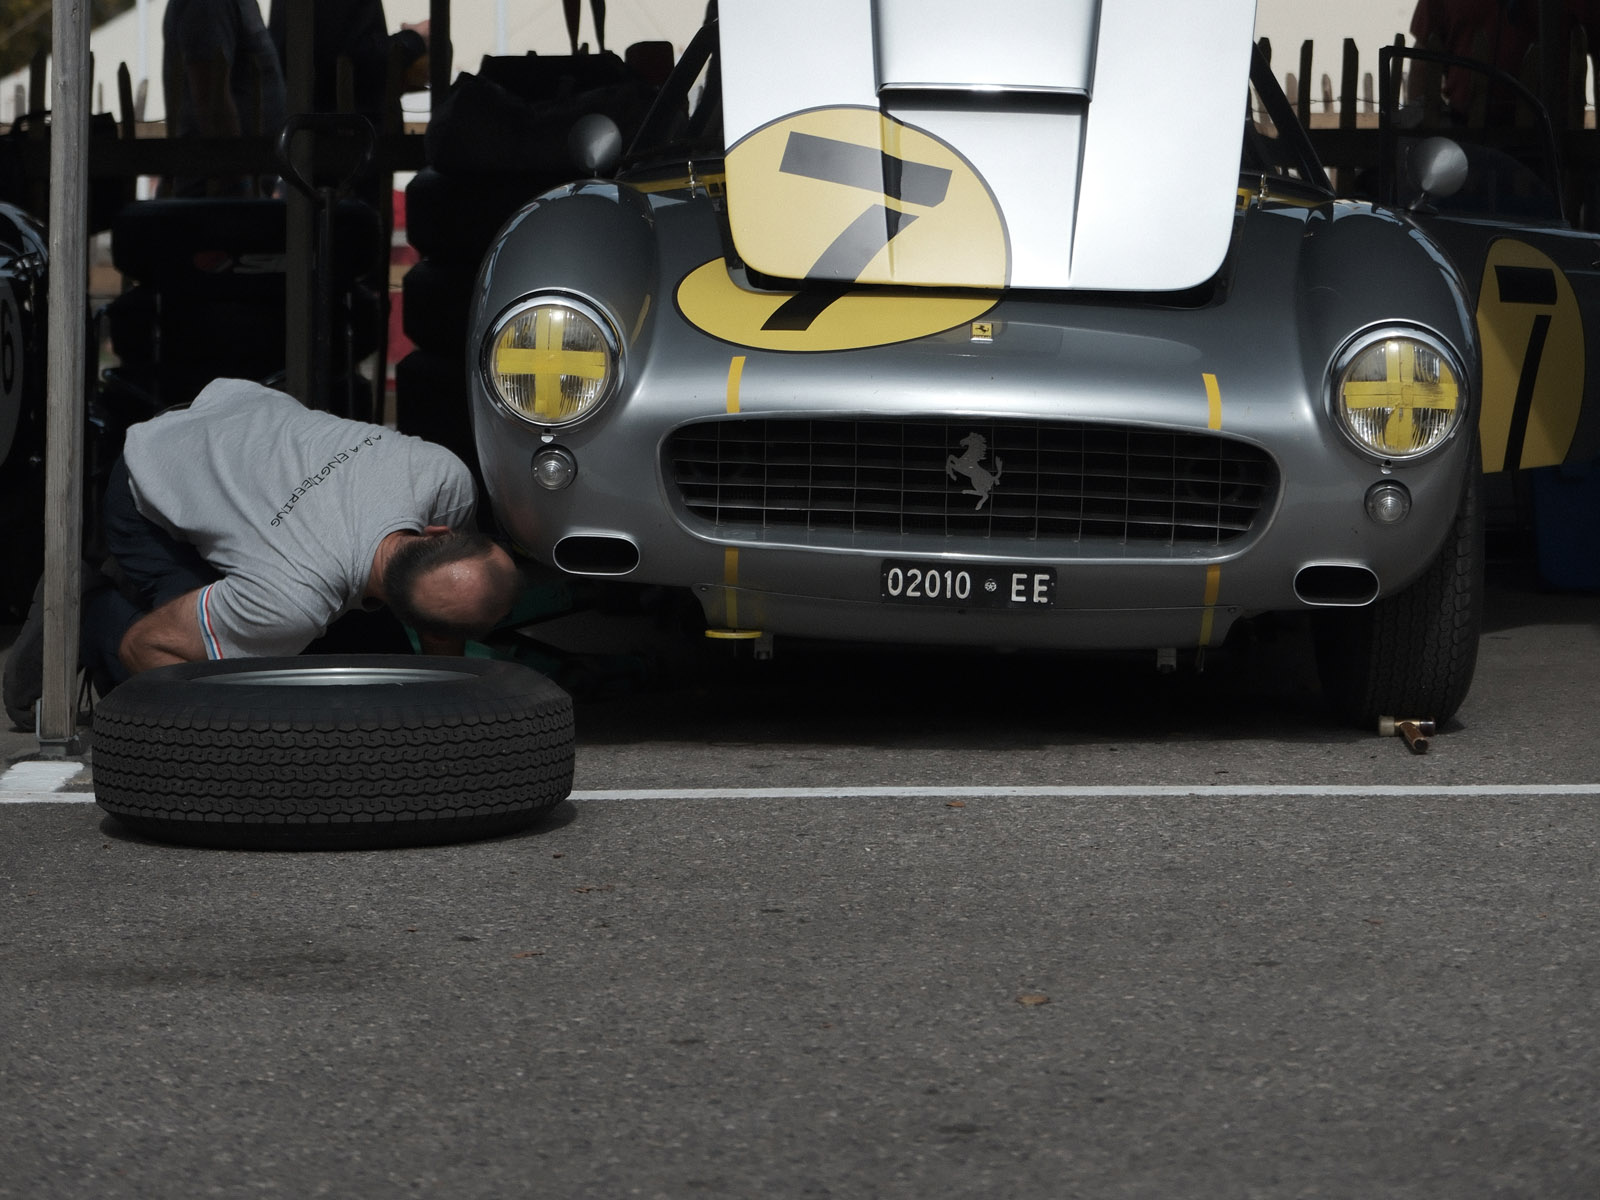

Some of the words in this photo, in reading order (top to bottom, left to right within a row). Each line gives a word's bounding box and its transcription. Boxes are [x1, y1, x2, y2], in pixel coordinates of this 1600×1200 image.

[760, 131, 952, 331] 7
[1494, 265, 1558, 471] 7
[887, 567, 971, 600] 02010
[1010, 573, 1050, 603] EE
